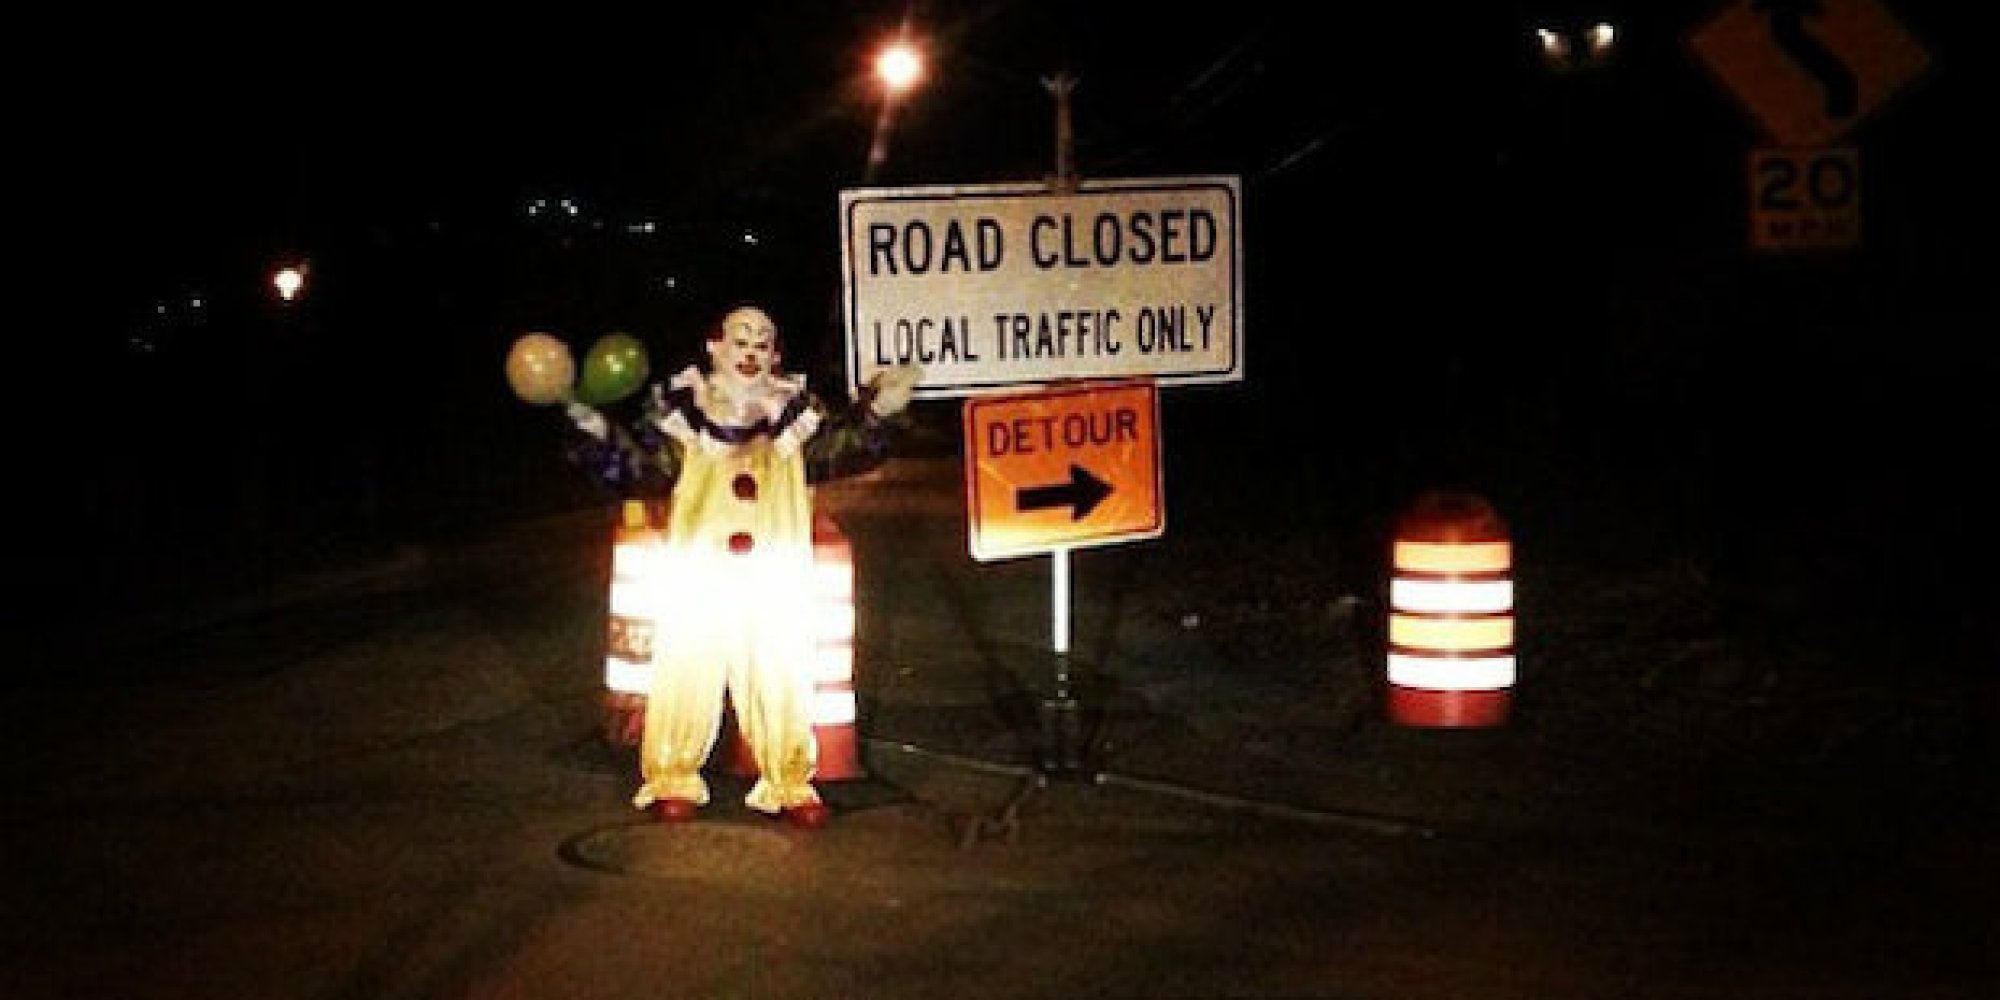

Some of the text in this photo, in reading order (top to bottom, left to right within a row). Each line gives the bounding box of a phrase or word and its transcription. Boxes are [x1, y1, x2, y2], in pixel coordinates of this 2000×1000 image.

[1758, 158, 1853, 209] 20
[868, 209, 1217, 275] ROAD CLOSED
[874, 305, 1214, 366] LOCAL TRAFFIC ONLY
[988, 408, 1138, 458] DETOUR
